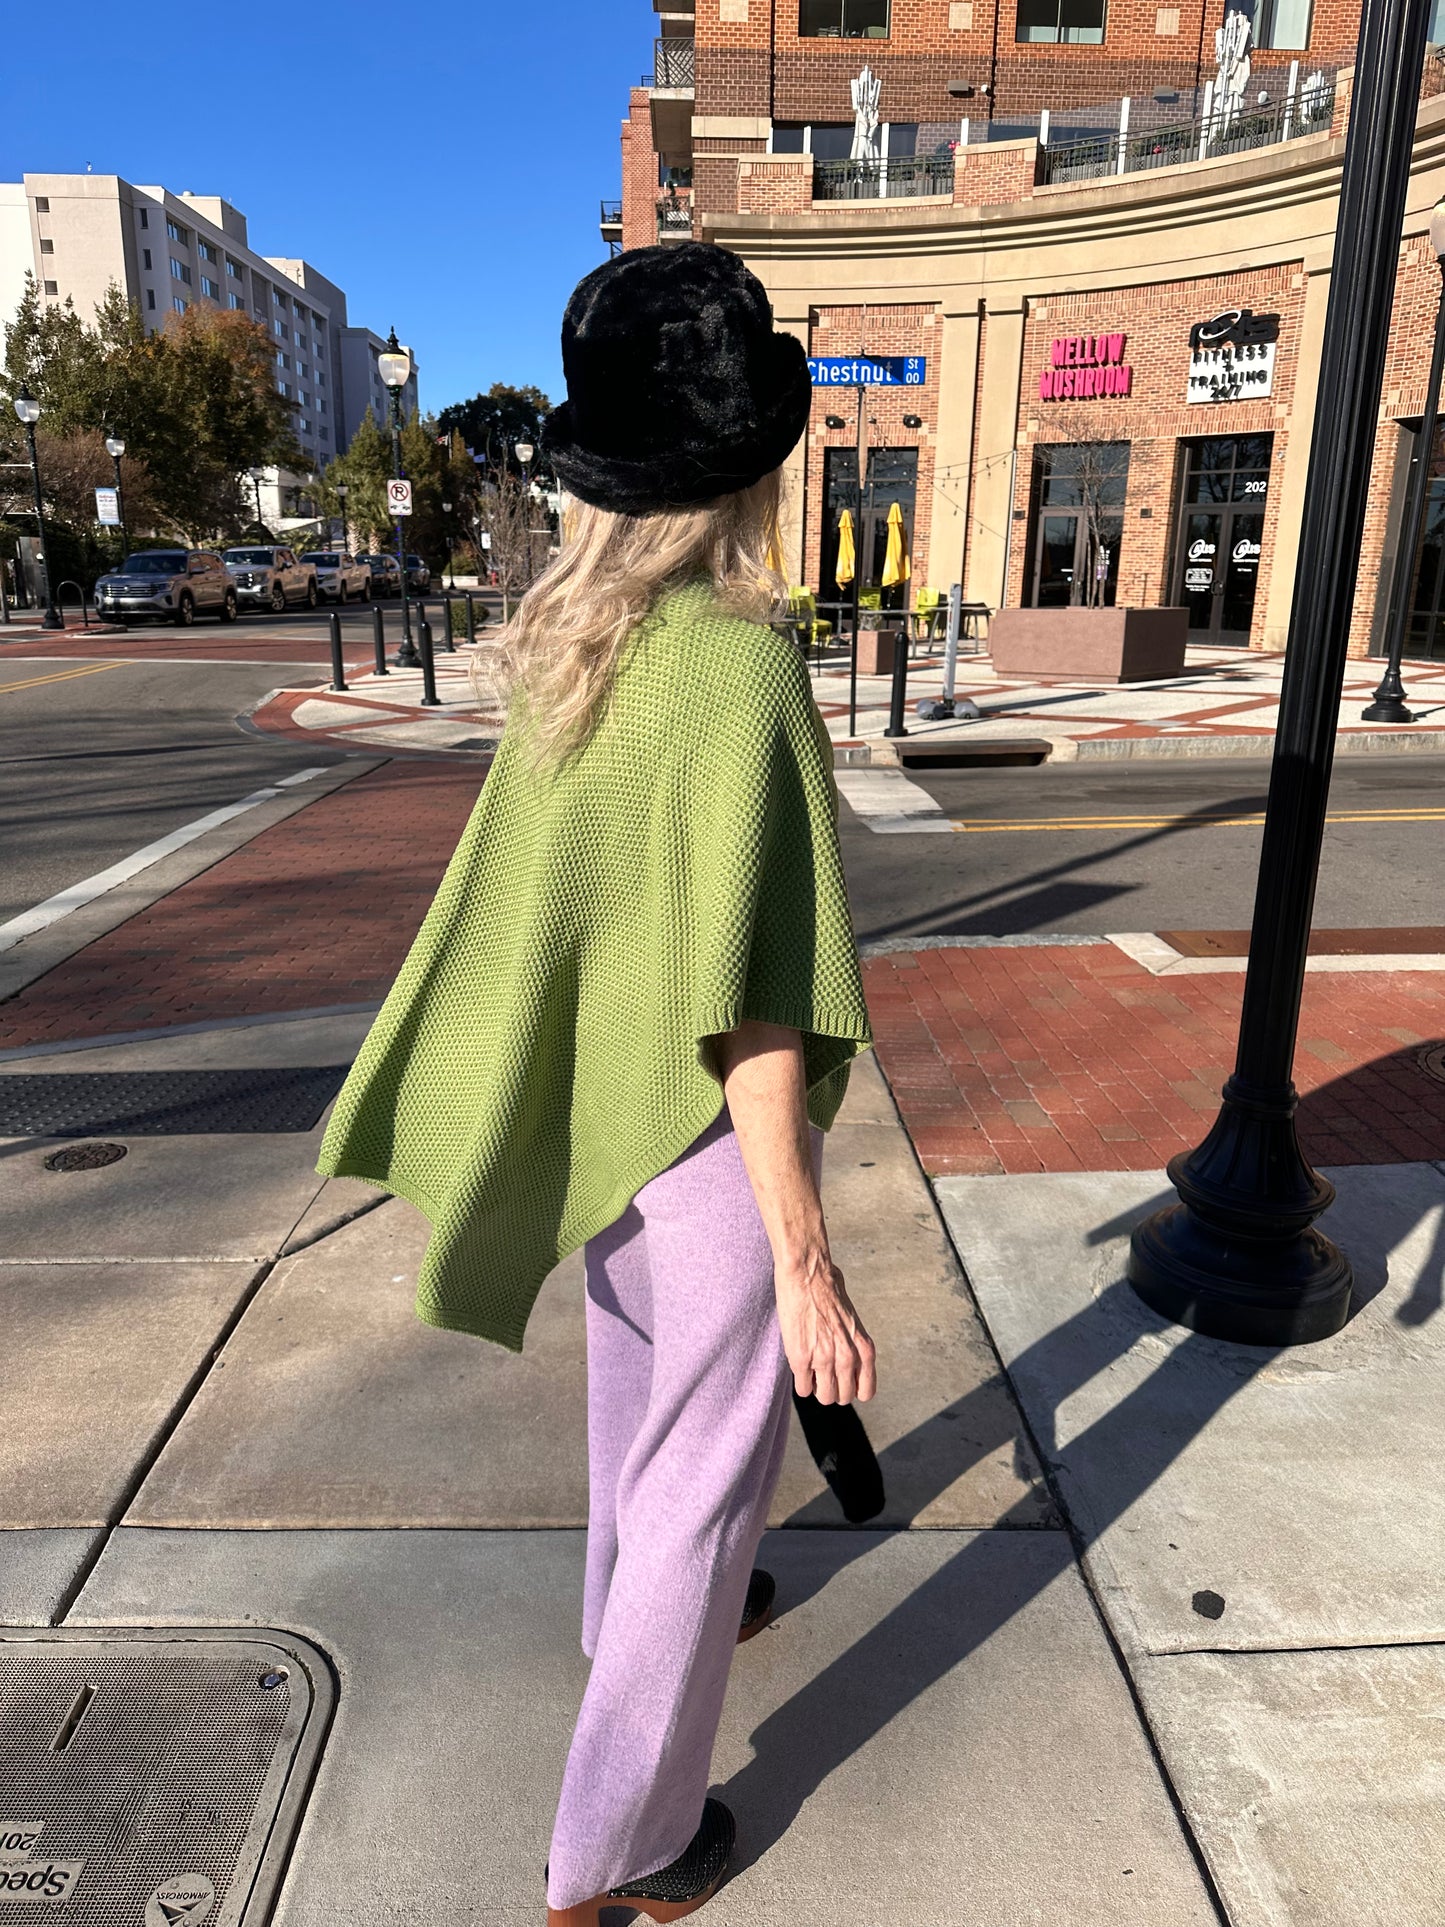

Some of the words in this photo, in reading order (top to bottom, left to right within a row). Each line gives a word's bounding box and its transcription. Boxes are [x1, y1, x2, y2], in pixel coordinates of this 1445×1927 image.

[1050, 333, 1127, 368] MELLOW
[1192, 344, 1268, 364] FITNESS
[807, 361, 892, 382] Chestnut
[907, 358, 919, 369] St
[905, 372, 920, 383] 00
[1189, 370, 1268, 389] TRAINING
[1040, 365, 1133, 401] MUSHROOM
[1244, 481, 1267, 493] 202
